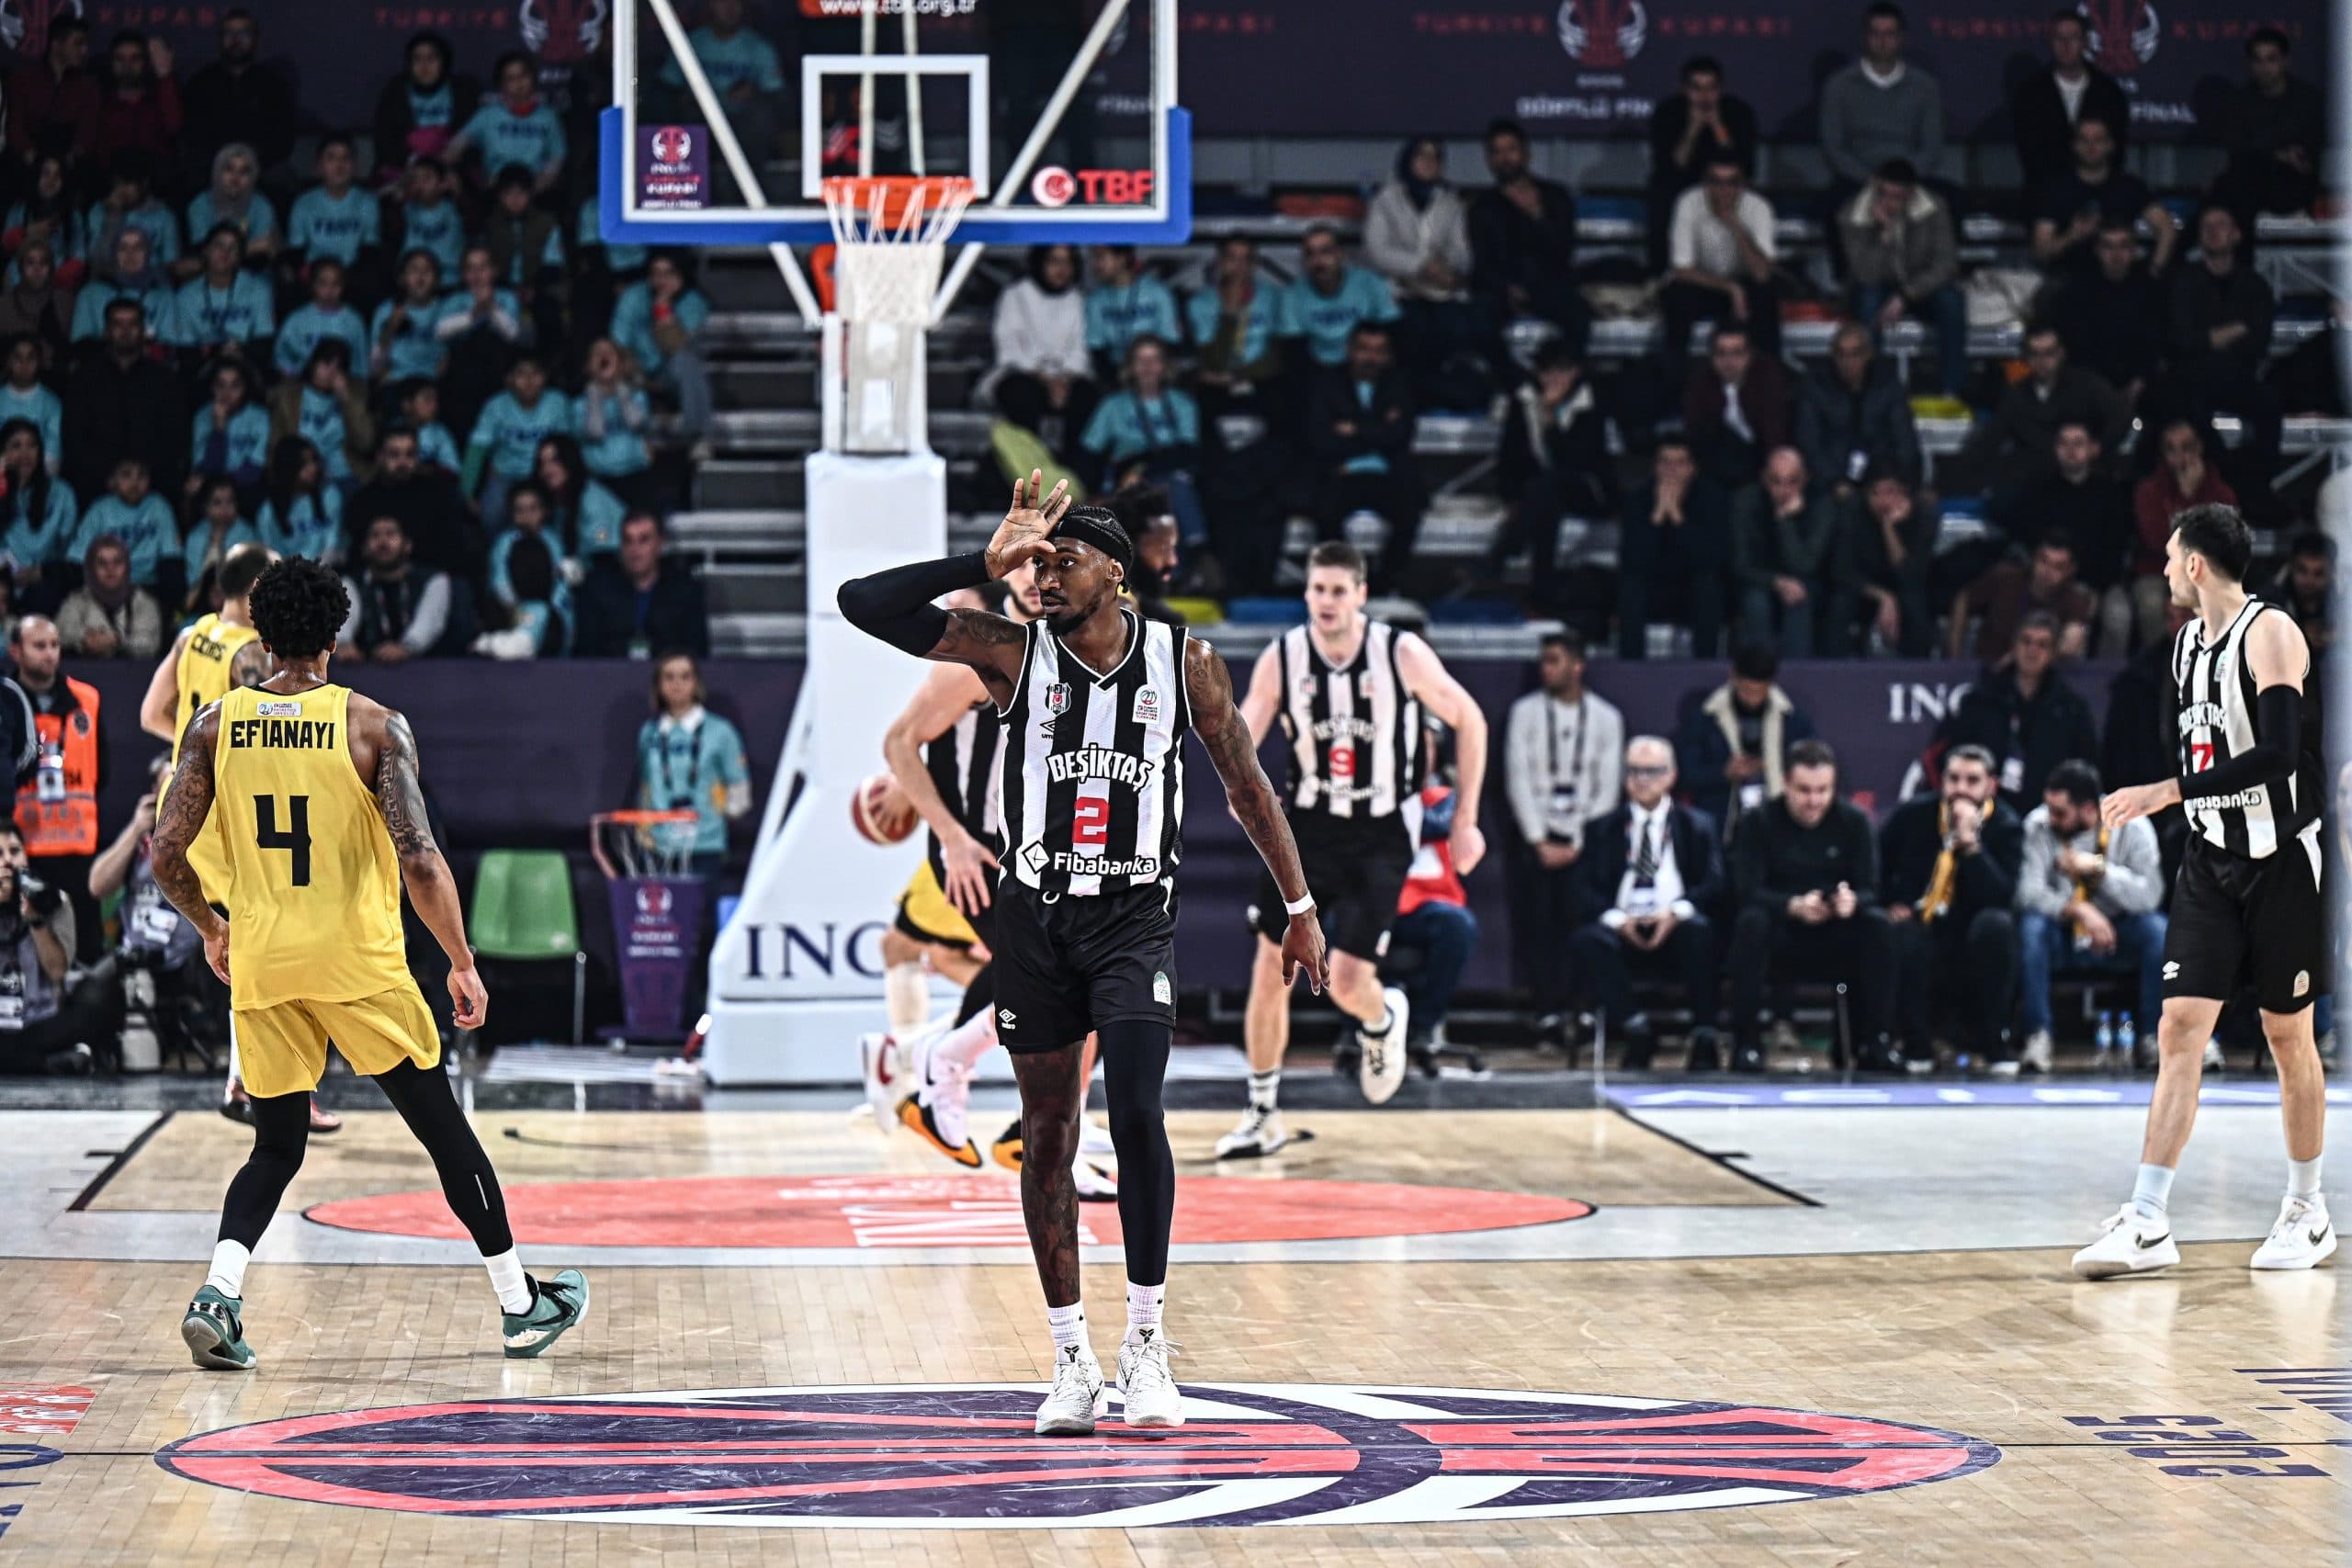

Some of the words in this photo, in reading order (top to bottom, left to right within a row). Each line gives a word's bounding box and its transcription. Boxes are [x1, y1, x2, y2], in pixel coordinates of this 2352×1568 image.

[1076, 169, 1155, 204] TBF
[231, 719, 335, 750] EFIANAYI
[1046, 742, 1155, 792] BEŞİKTAŞ
[2191, 744, 2215, 773] 7
[1073, 796, 1110, 844] 2
[253, 795, 312, 887] 4
[1053, 851, 1158, 876] Fibabanka
[2062, 1415, 2333, 1477] 2025
